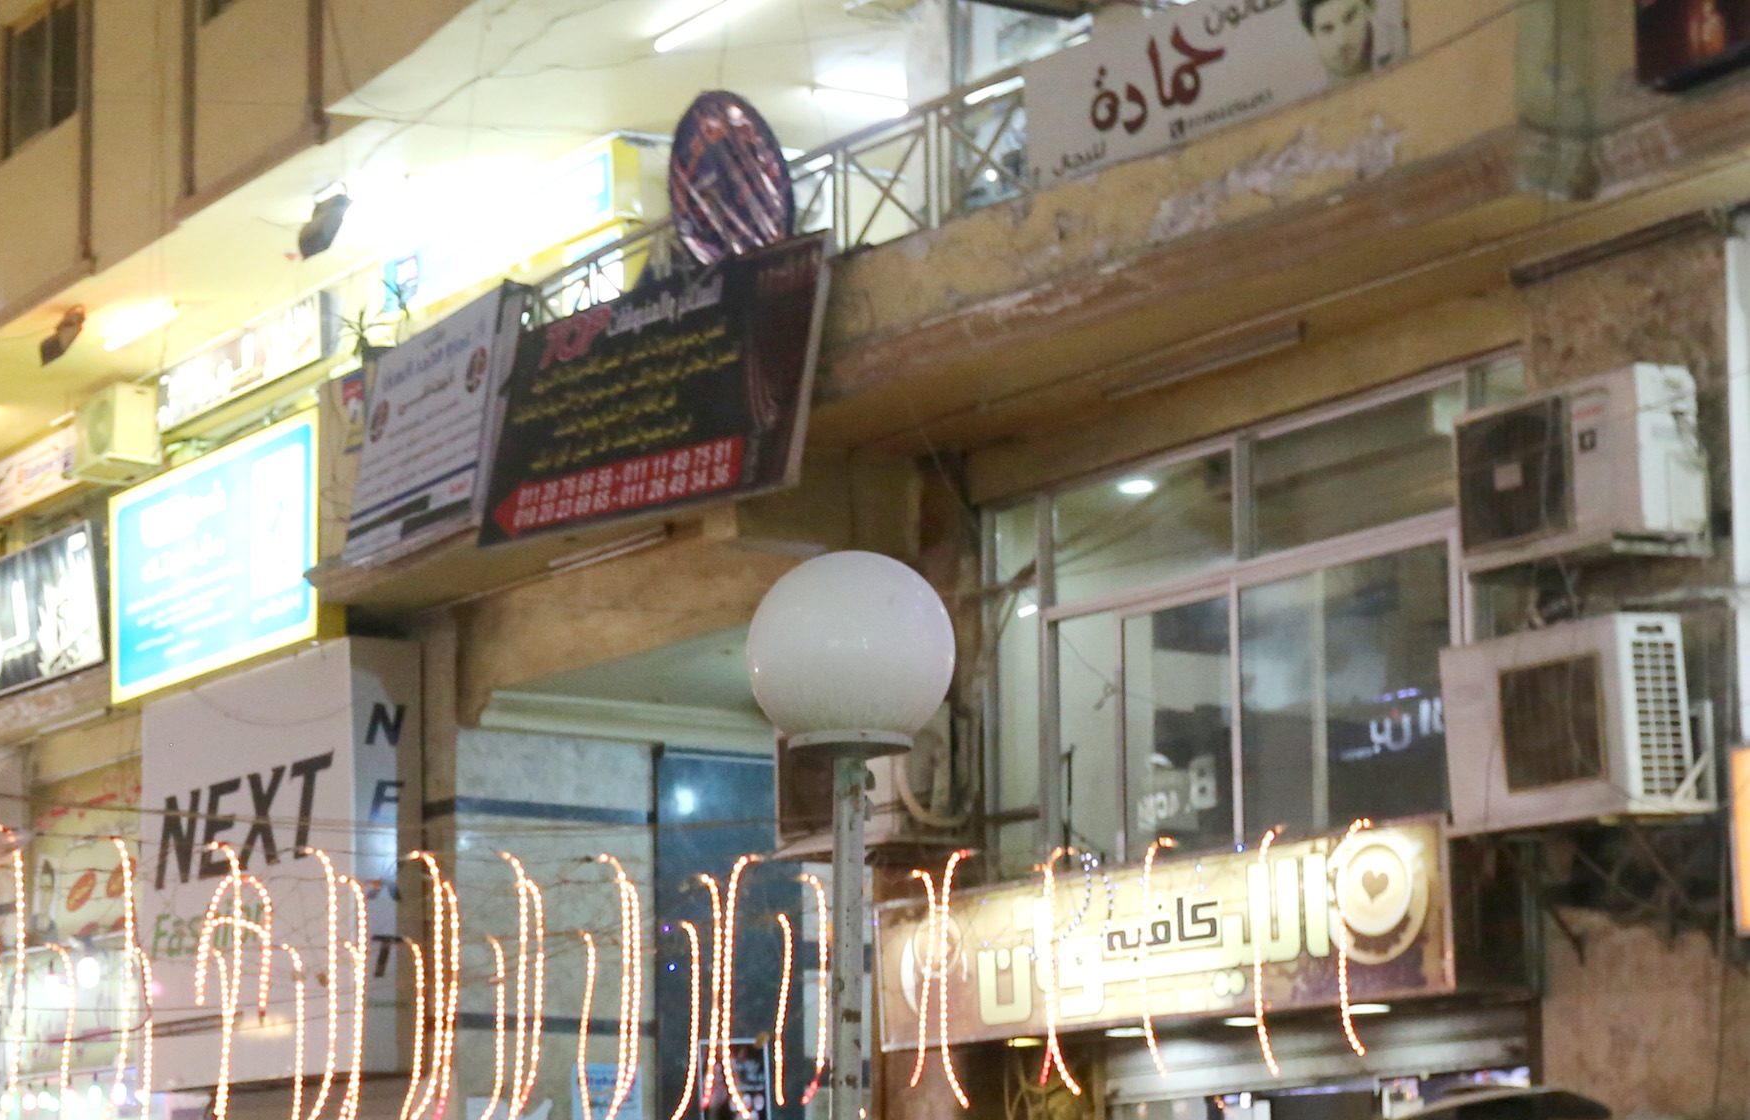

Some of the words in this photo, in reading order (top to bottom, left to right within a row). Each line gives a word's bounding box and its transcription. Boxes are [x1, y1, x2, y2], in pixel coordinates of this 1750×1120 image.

[1090, 24, 1226, 135] حمادة
[155, 748, 335, 890] NEXT
[1107, 897, 1219, 962] كافيه
